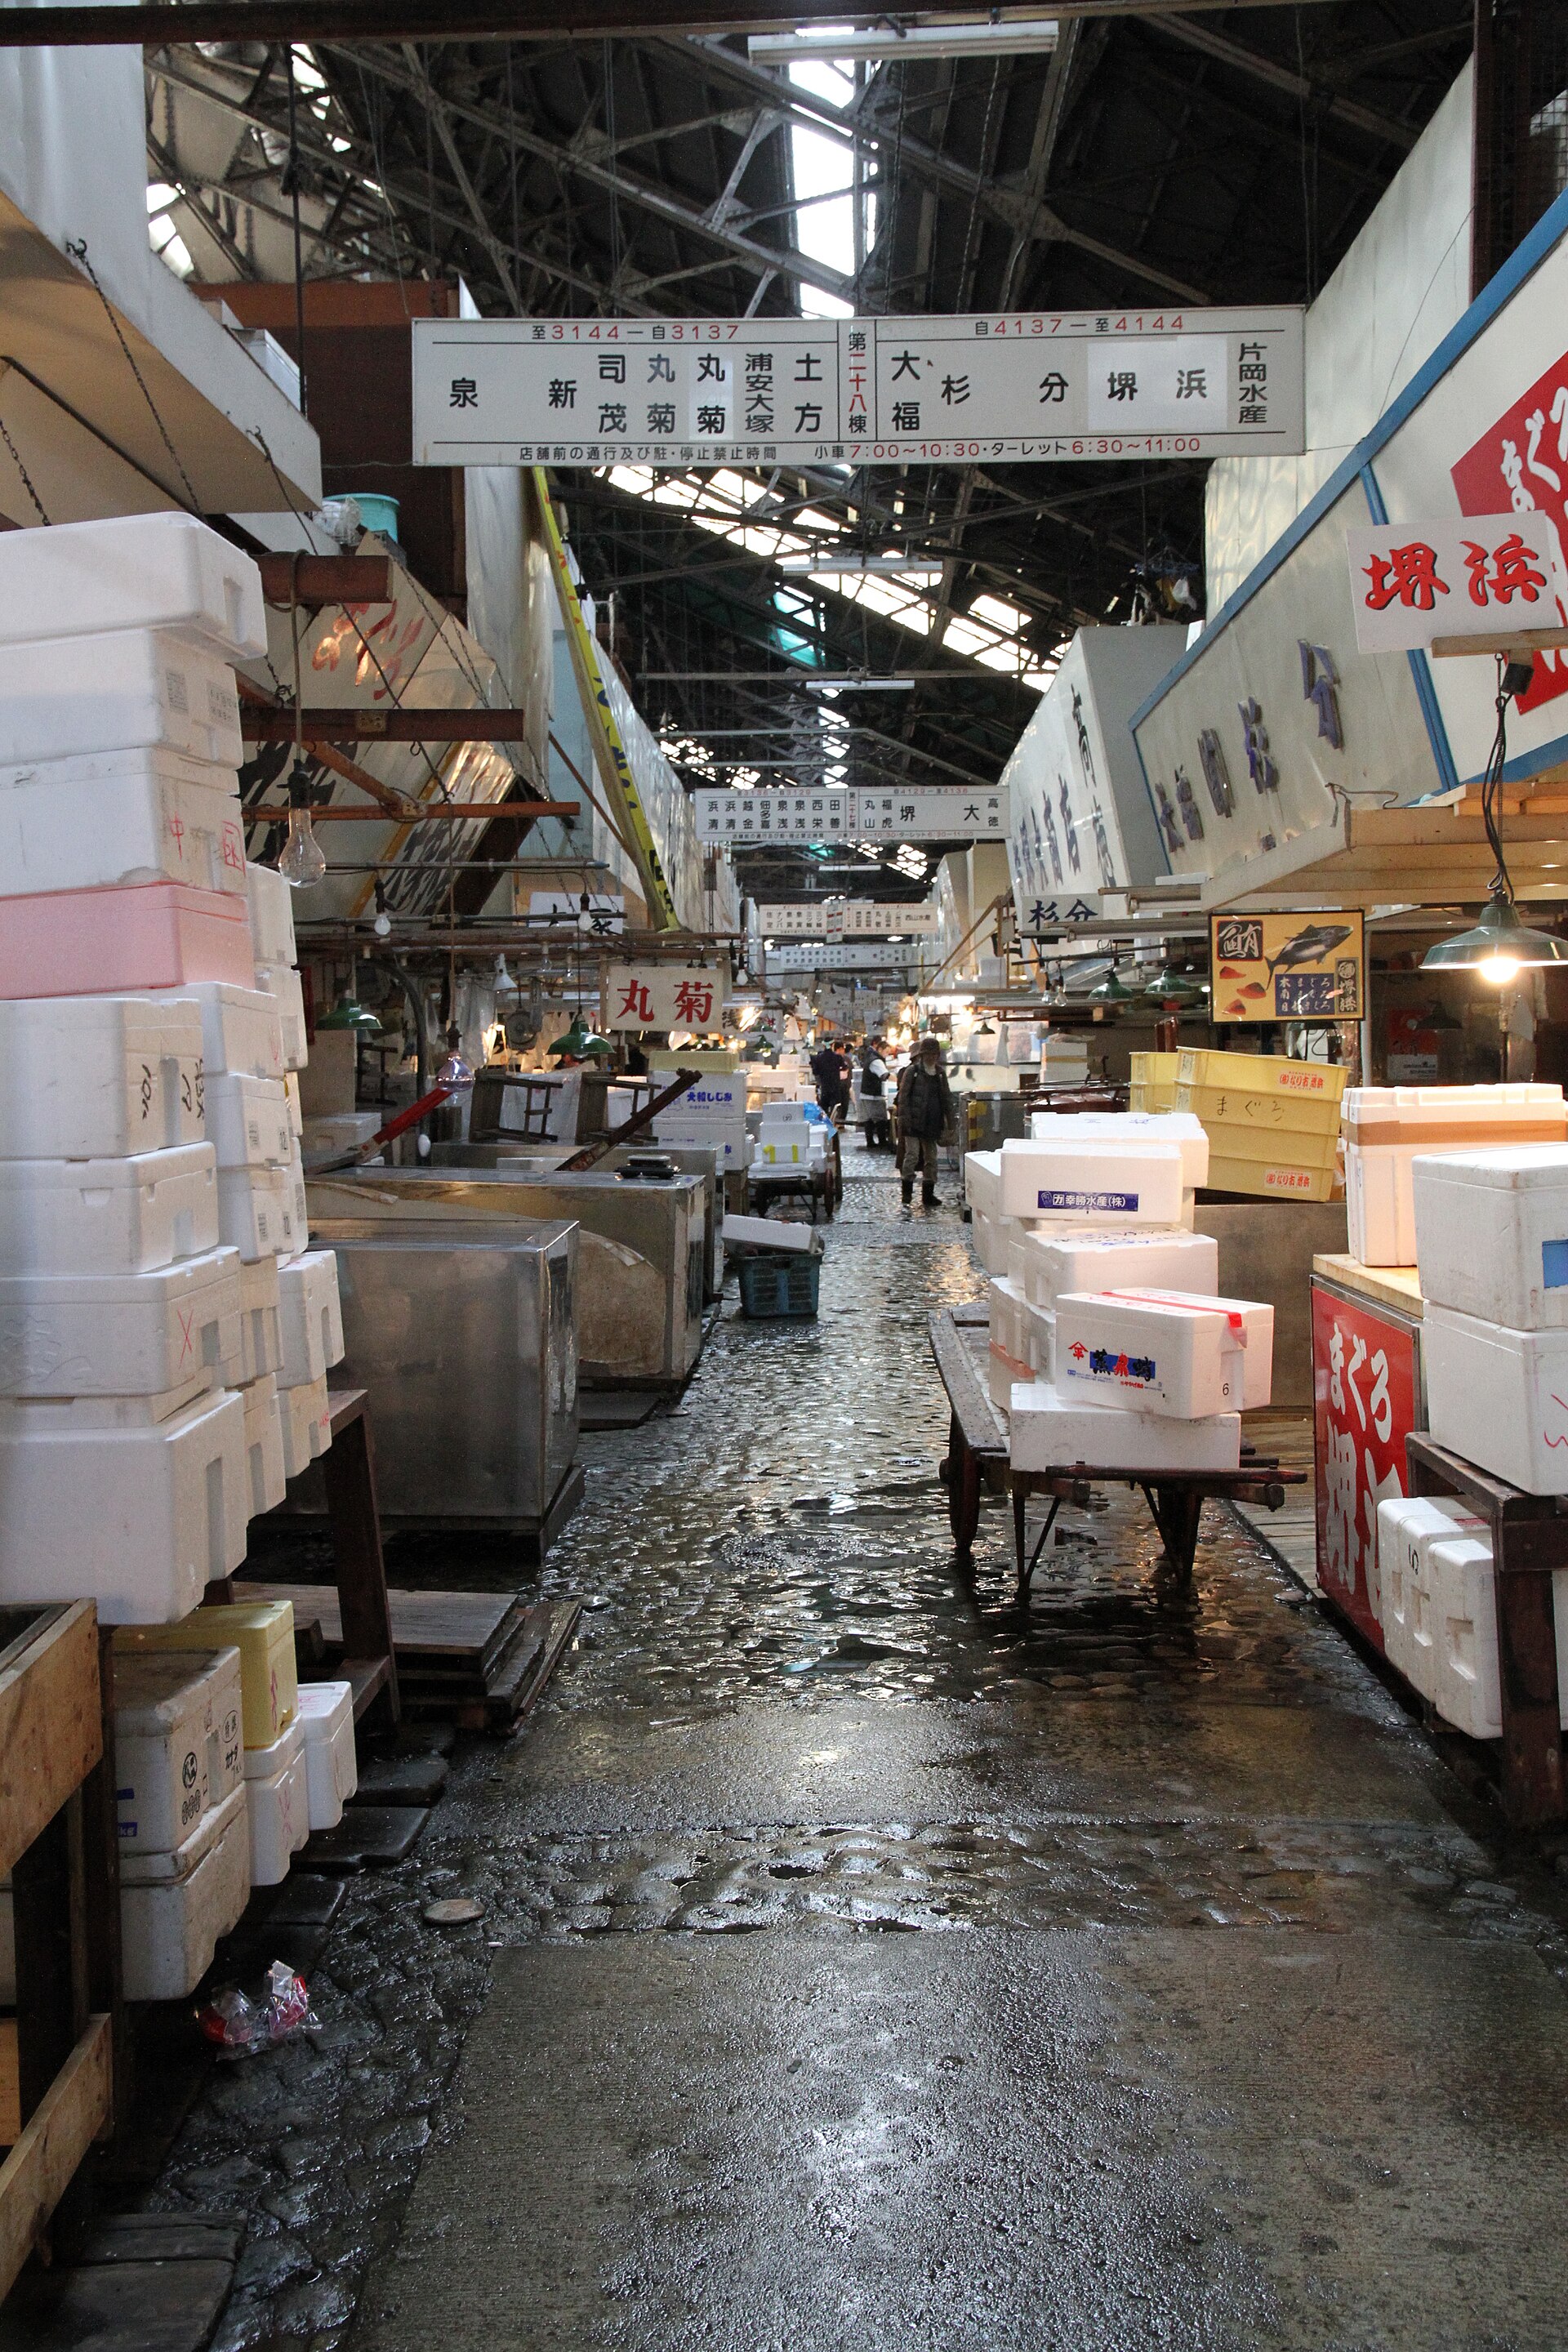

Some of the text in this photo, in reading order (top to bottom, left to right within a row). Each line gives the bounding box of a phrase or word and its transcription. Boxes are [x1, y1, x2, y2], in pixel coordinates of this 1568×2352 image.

[450, 377, 577, 408] 泉 新
[598, 354, 627, 434] 司茂
[647, 354, 676, 434] 丸菊
[697, 354, 726, 434] 丸菊
[745, 353, 774, 434] 浦安大塚
[794, 354, 822, 433] 土方
[848, 332, 868, 434] 第二十八棟
[890, 350, 921, 432] 大福
[941, 372, 1069, 406] 杉 分
[1238, 342, 1267, 424] 片岡水産
[1361, 533, 1547, 611] 堺浜
[616, 979, 715, 1023] 丸菊
[1329, 1322, 1393, 1444] まぐろ
